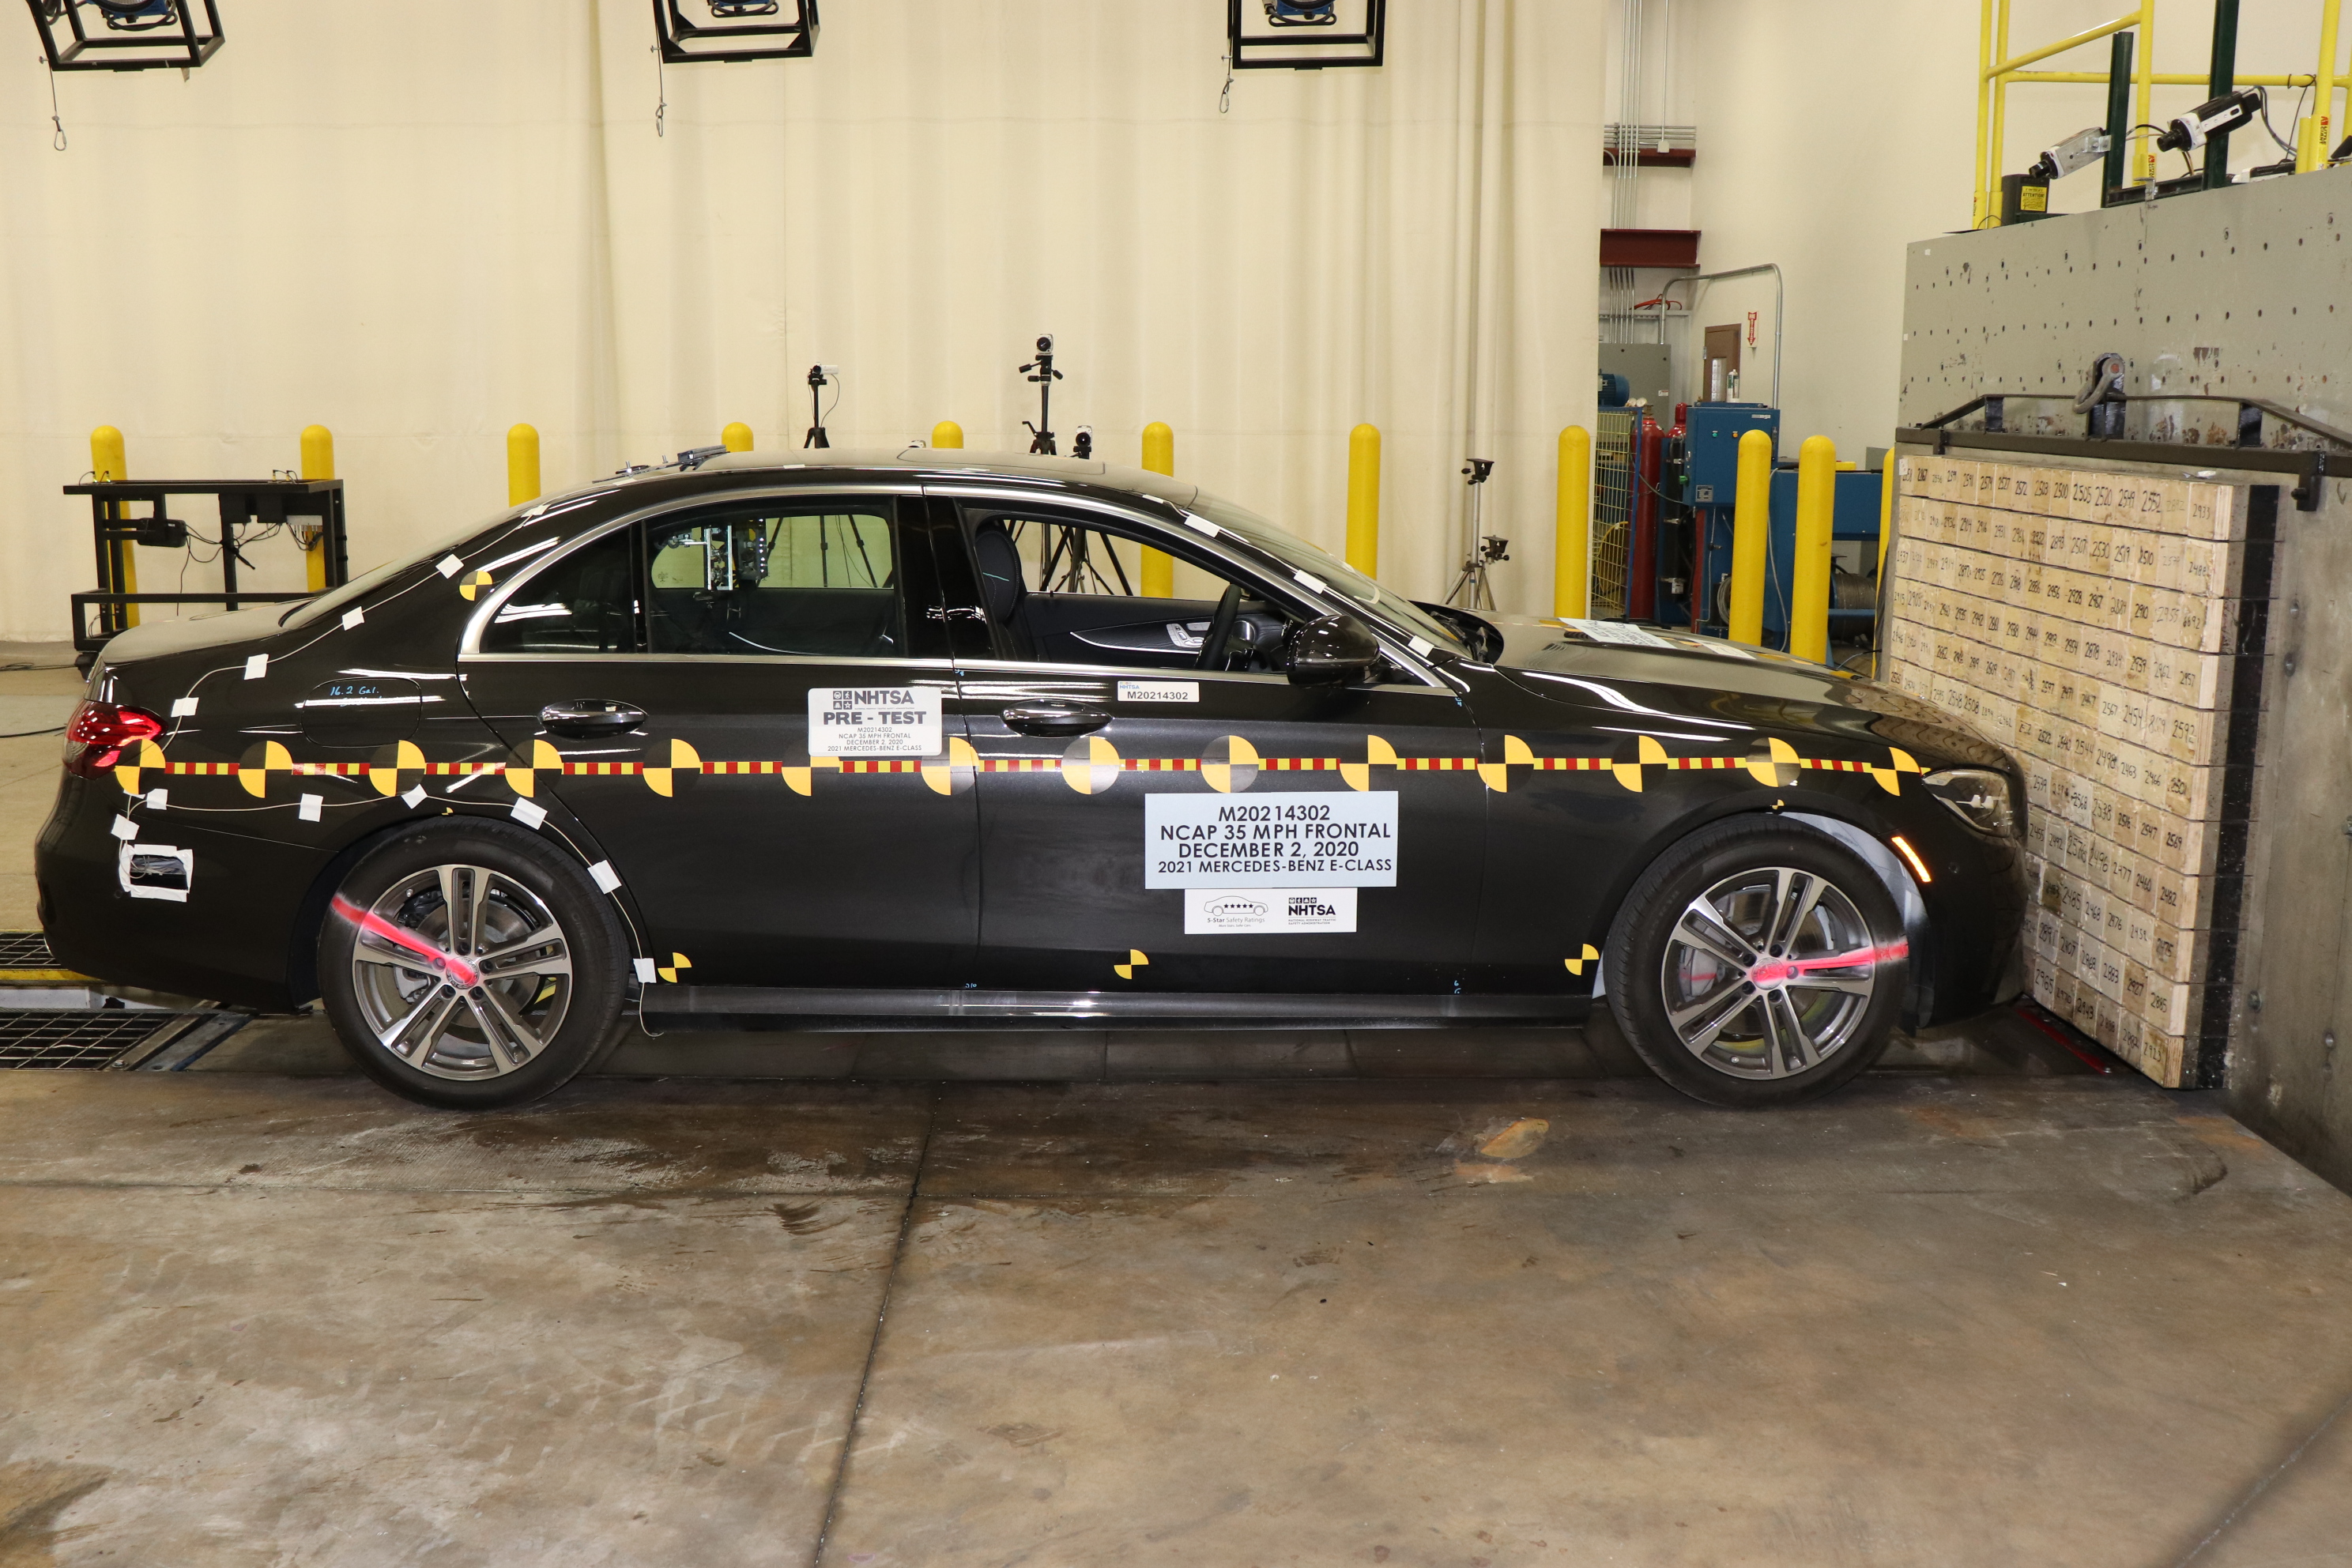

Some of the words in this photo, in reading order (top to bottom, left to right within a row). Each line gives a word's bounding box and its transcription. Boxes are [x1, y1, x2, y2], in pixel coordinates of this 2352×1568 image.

[2053, 482, 2068, 499] 2500
[2073, 483, 2092, 503] 2505
[2094, 486, 2113, 507] 2520
[2141, 490, 2162, 513] 2552
[2192, 503, 2210, 520] 2933
[2071, 537, 2087, 554] 2507
[2092, 541, 2110, 559] 2530
[2114, 545, 2130, 563] 2519
[2157, 606, 2180, 623] 2955
[330, 686, 353, 695] 16.2
[854, 690, 914, 704] NHTSA
[1127, 691, 1189, 700] M20214302
[2102, 701, 2118, 716] 2567
[2123, 705, 2143, 729] 2454
[824, 711, 863, 725] PRE
[878, 710, 927, 725] TEST
[2172, 719, 2196, 743] 2592
[2075, 739, 2094, 756] 2544
[2120, 762, 2137, 778] 2463
[2145, 770, 2162, 786] 2466
[1219, 805, 1331, 822] M20214302
[2092, 797, 2112, 821] 2538
[1160, 825, 1218, 840] NCAP
[1224, 824, 1246, 840] 35
[1253, 824, 1298, 839] MPH
[1305, 823, 1391, 839] FRONTAL
[2140, 822, 2158, 839] 2547
[2166, 831, 2182, 850] 2569
[1178, 842, 1284, 858] DECEMBER
[1291, 842, 1306, 858] 2,
[1314, 841, 1359, 857] 2020
[1158, 861, 1193, 873] 2021
[1199, 860, 1325, 873] MERCEDES-BENZ
[1330, 858, 1392, 871] E-CLASS
[2062, 887, 2081, 910] 2485
[1288, 904, 1336, 916] NHTSA
[2086, 902, 2101, 921] 2468
[2035, 968, 2054, 993] 2965
[2144, 1042, 2162, 1062] 2923
